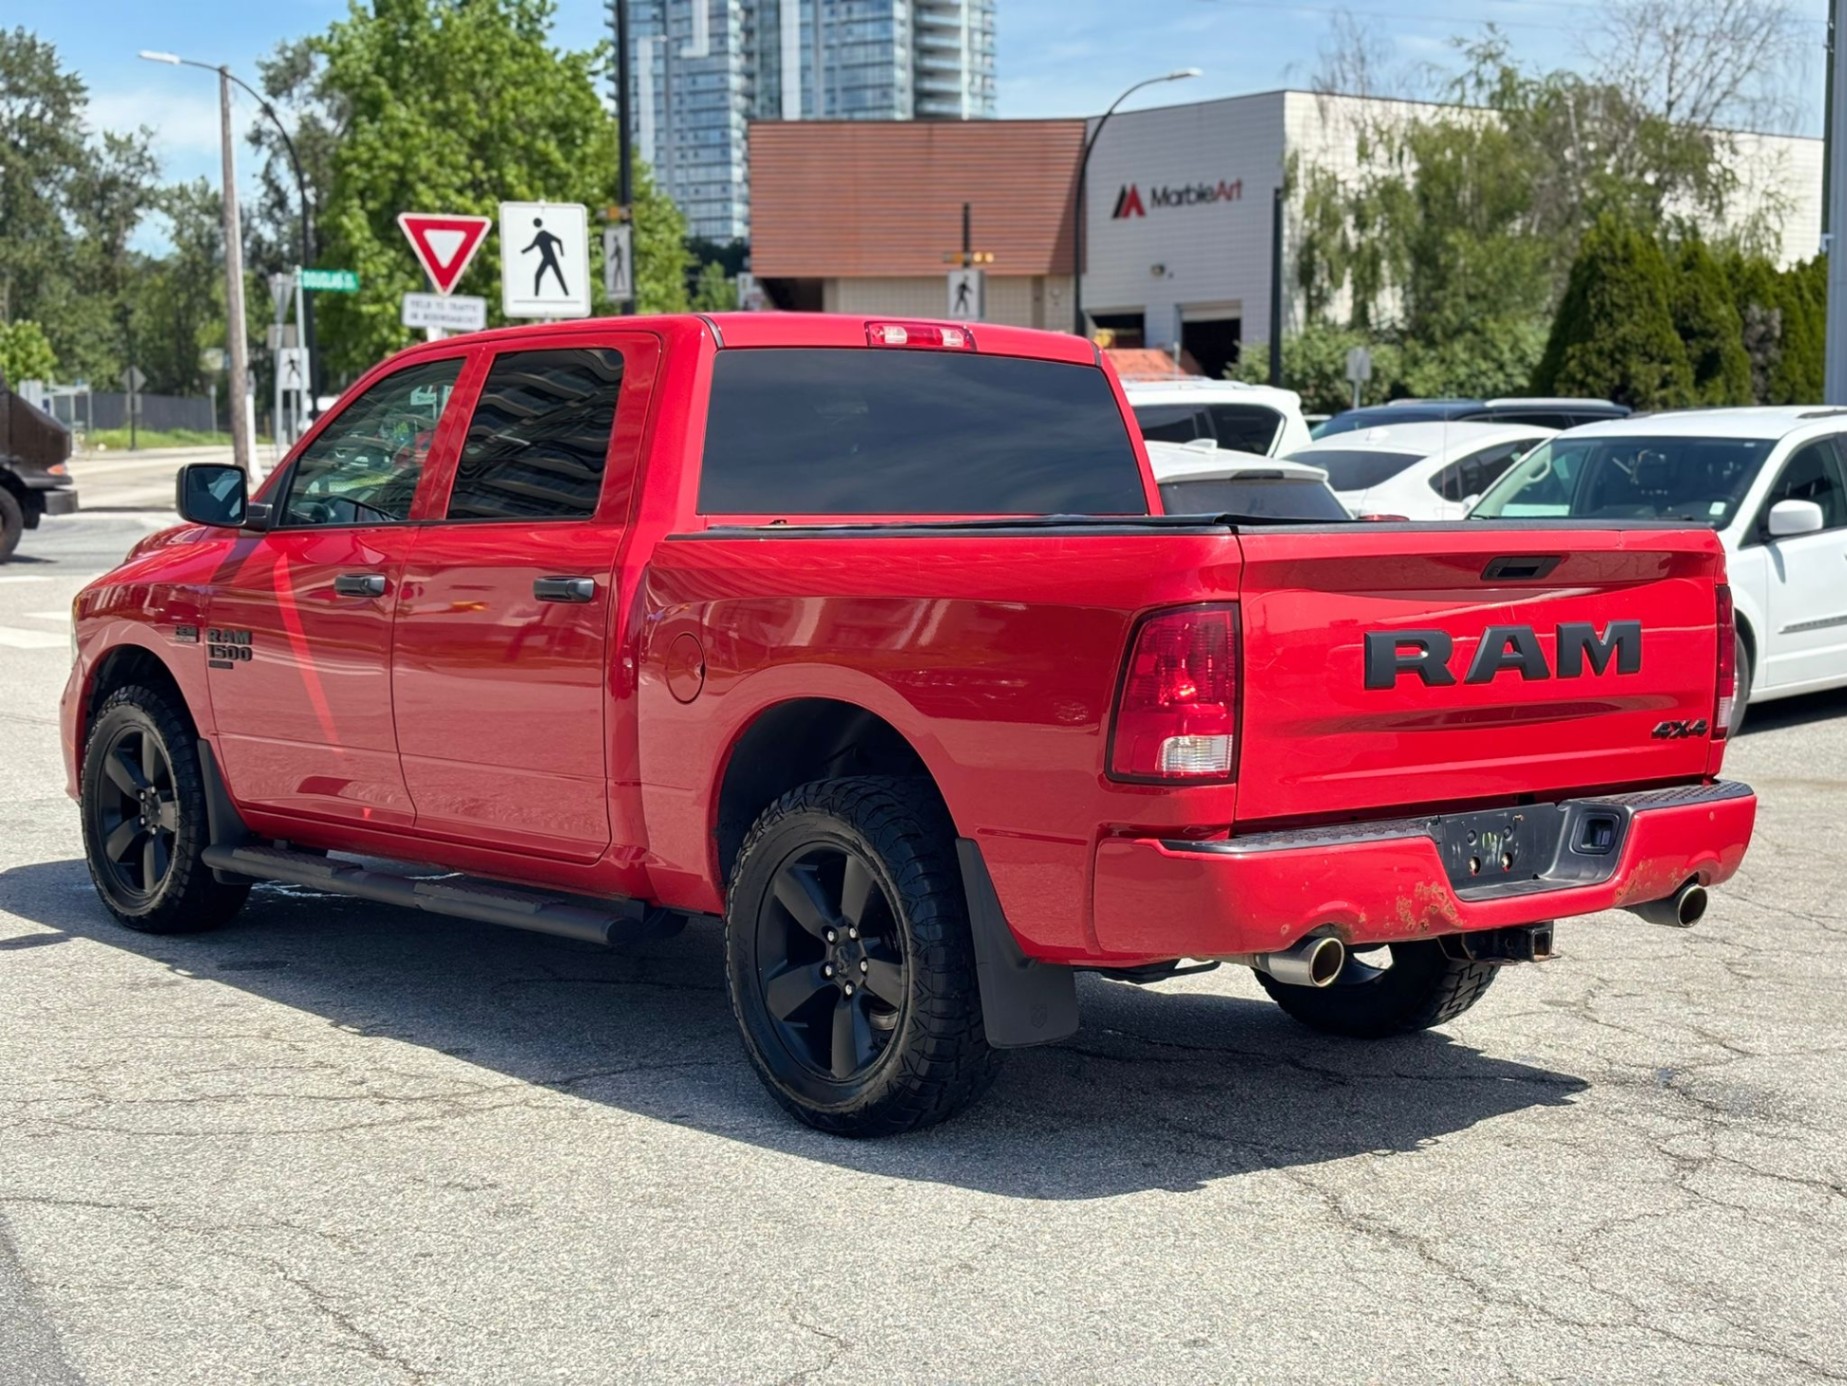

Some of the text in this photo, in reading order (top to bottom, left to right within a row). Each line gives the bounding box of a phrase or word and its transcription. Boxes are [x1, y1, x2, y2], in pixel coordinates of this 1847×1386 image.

[1151, 178, 1243, 208] MarbleArt
[207, 628, 252, 645] RAM
[208, 644, 253, 661] 1500
[1364, 620, 1642, 690] RAM
